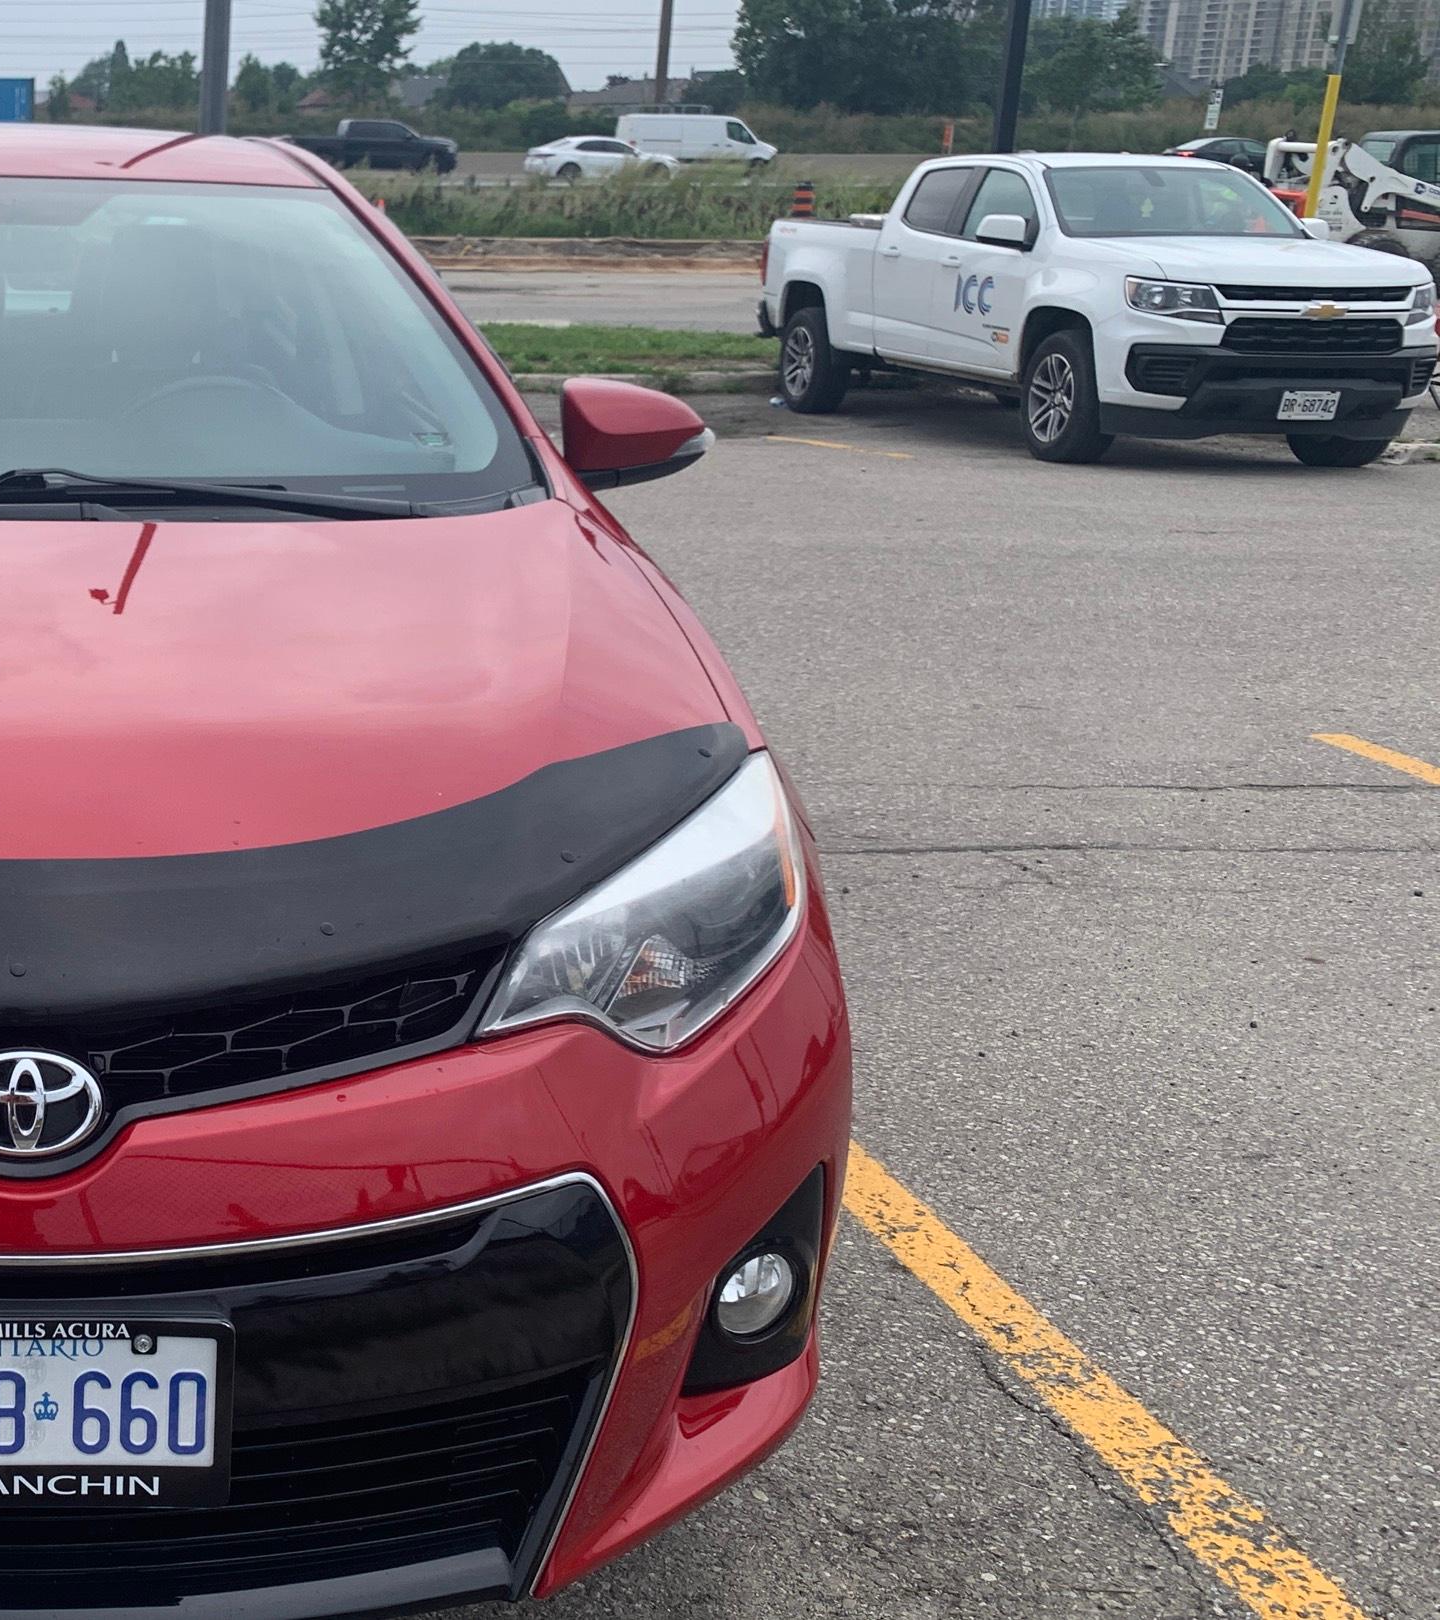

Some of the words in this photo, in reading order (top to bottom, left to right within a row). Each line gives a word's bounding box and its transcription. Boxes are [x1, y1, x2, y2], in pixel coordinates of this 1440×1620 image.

[953, 273, 994, 316] ICC
[52, 1323, 130, 1338] ACURA
[72, 1370, 208, 1455] 660
